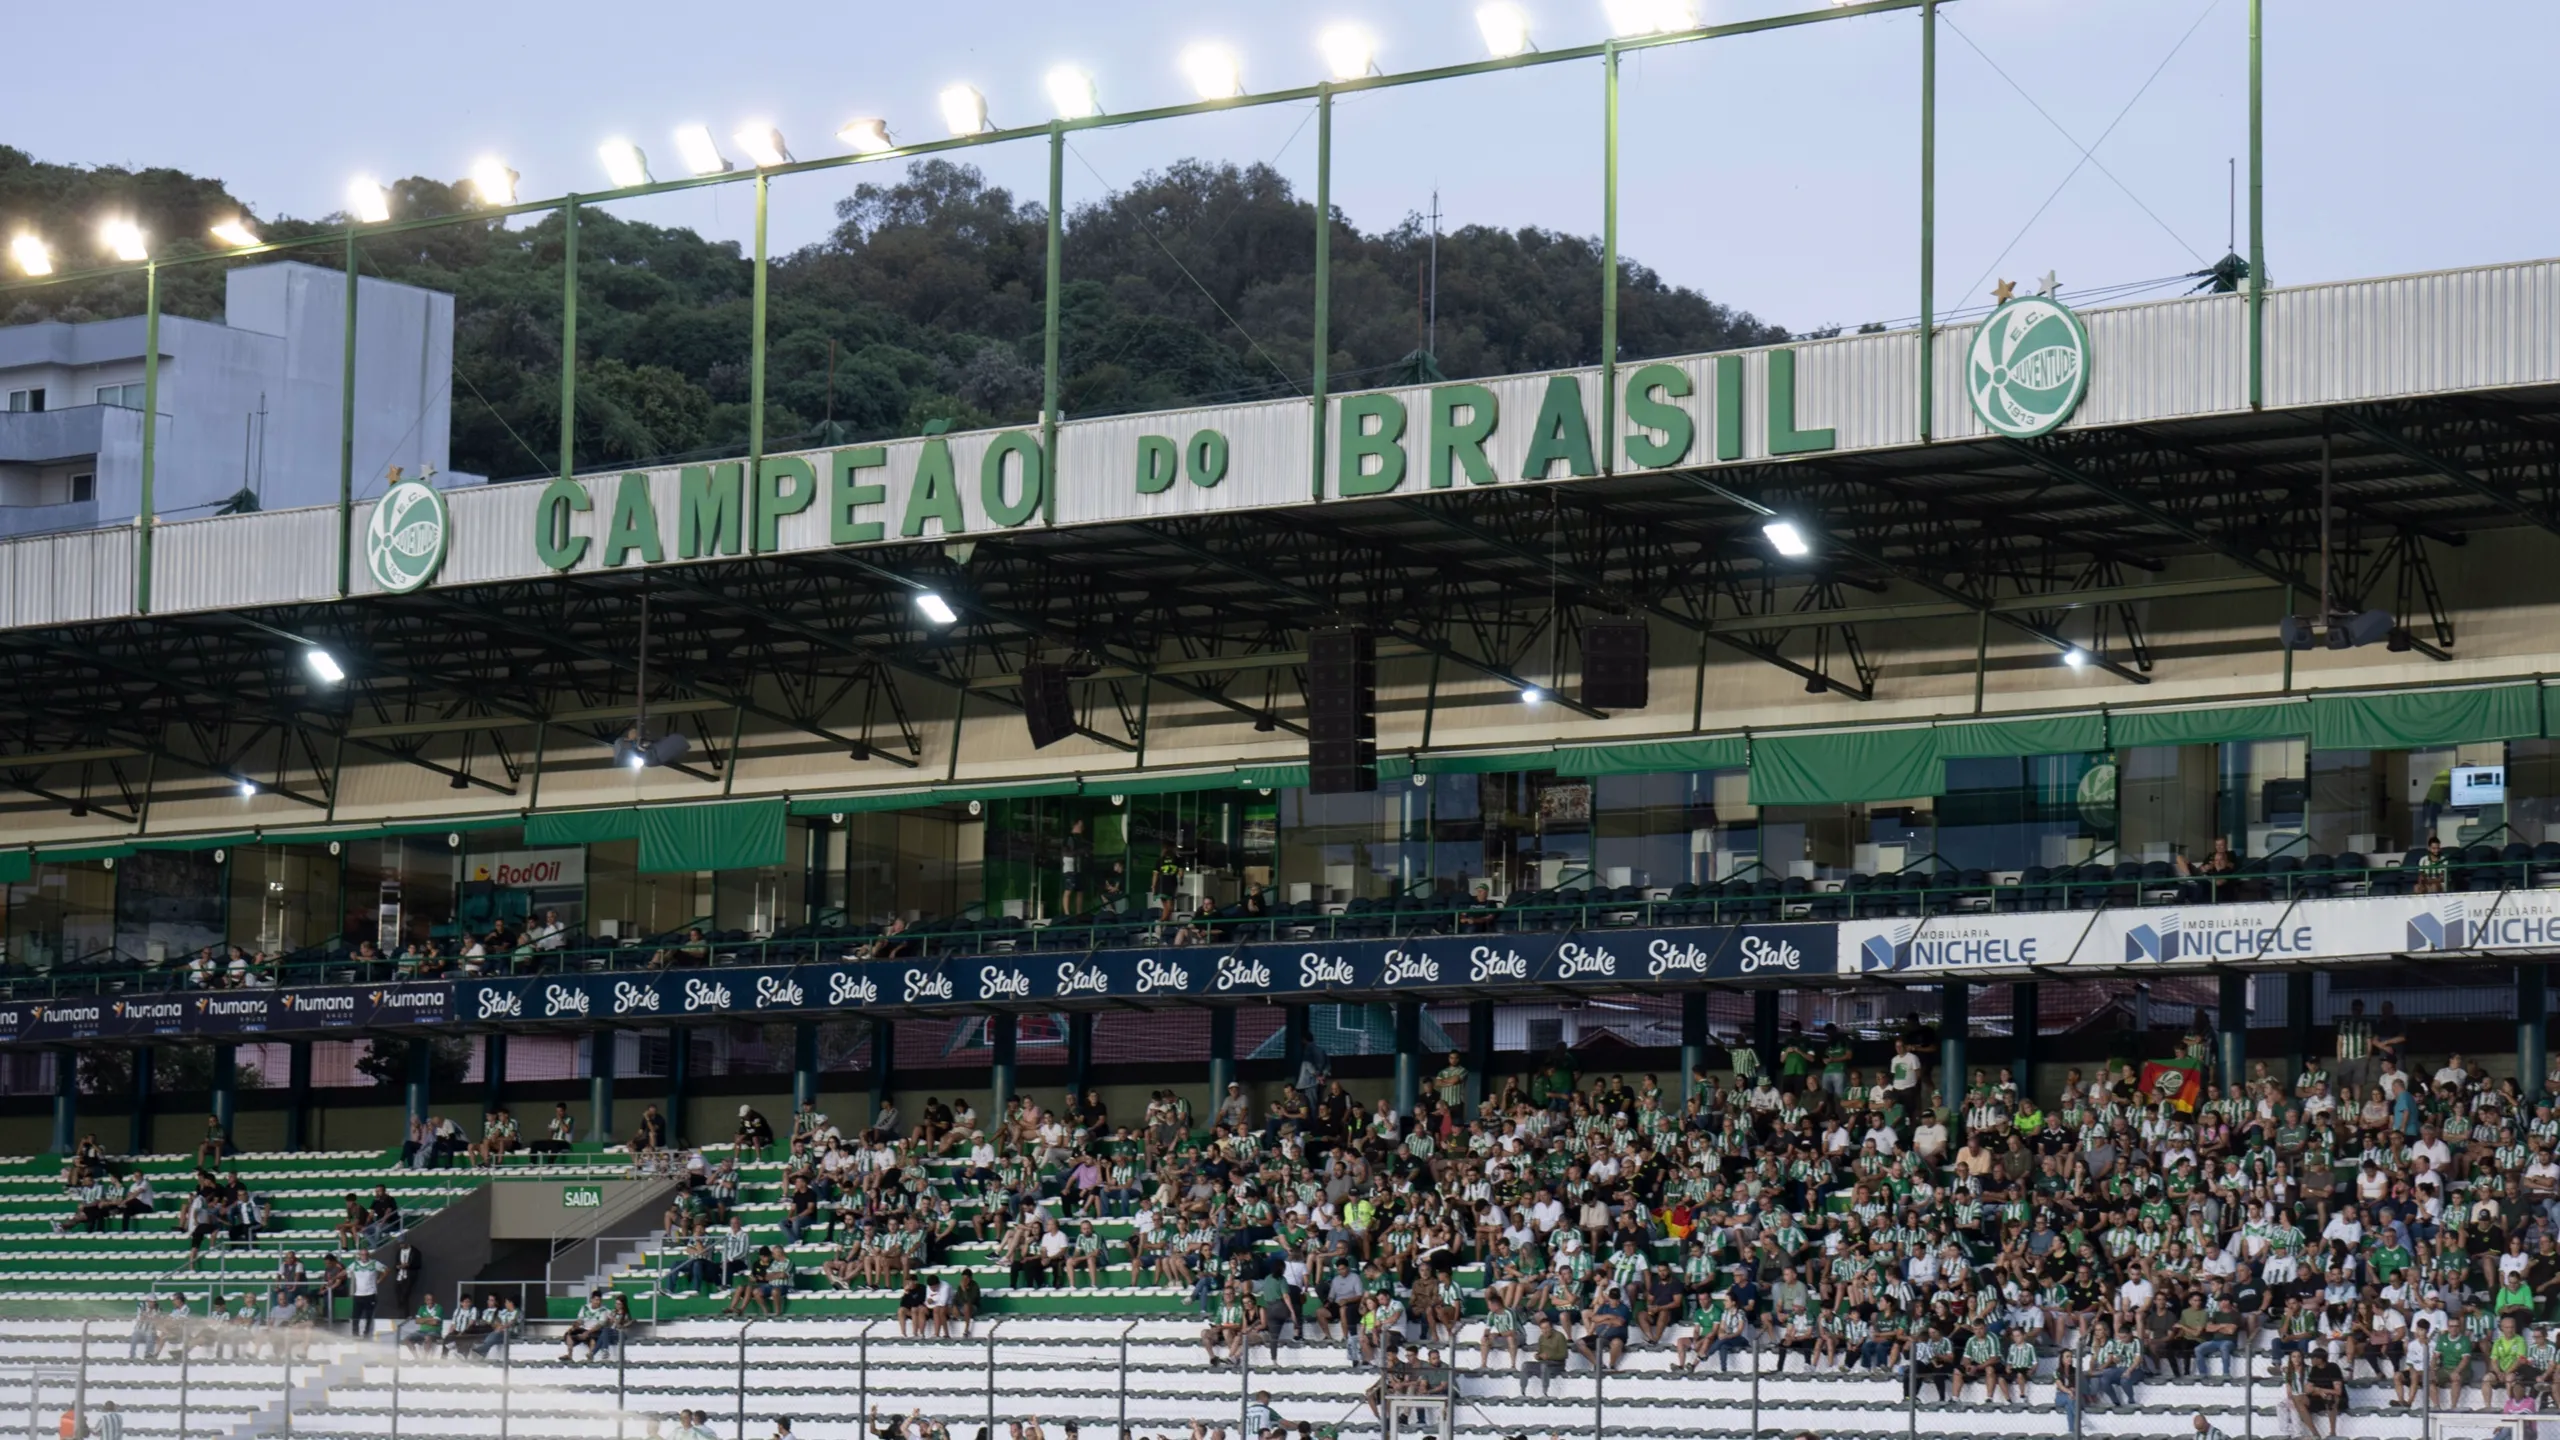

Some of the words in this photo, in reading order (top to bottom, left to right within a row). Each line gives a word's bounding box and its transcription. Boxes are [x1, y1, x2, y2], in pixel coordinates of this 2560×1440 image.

[2010, 311, 2044, 342] E.C.
[2013, 348, 2077, 388] JUVENTUDE
[2008, 401, 2035, 426] 1913
[535, 418, 1044, 570] CAMPEÃO
[1136, 428, 1229, 494] DO
[1339, 348, 1836, 497] BRASIL
[497, 861, 562, 884] RodOil
[1741, 936, 1800, 972] Stake
[1915, 938, 2037, 966] NICHELE
[2183, 926, 2312, 956] NICHELE
[1217, 956, 1270, 990] Stake
[1300, 953, 1353, 987] Stake
[1384, 950, 1439, 984] Stake
[1470, 946, 1526, 982] Stake
[1559, 943, 1615, 978] Stake
[1648, 939, 1707, 978] Stake
[829, 972, 877, 1005] Stake
[980, 966, 1029, 999] Stake
[1057, 962, 1107, 995] Stake
[1136, 959, 1188, 992] Stake
[294, 994, 354, 1012] humana
[546, 985, 589, 1016] Stake
[685, 979, 730, 1010] Stake
[564, 1187, 600, 1207] SAÍDA
